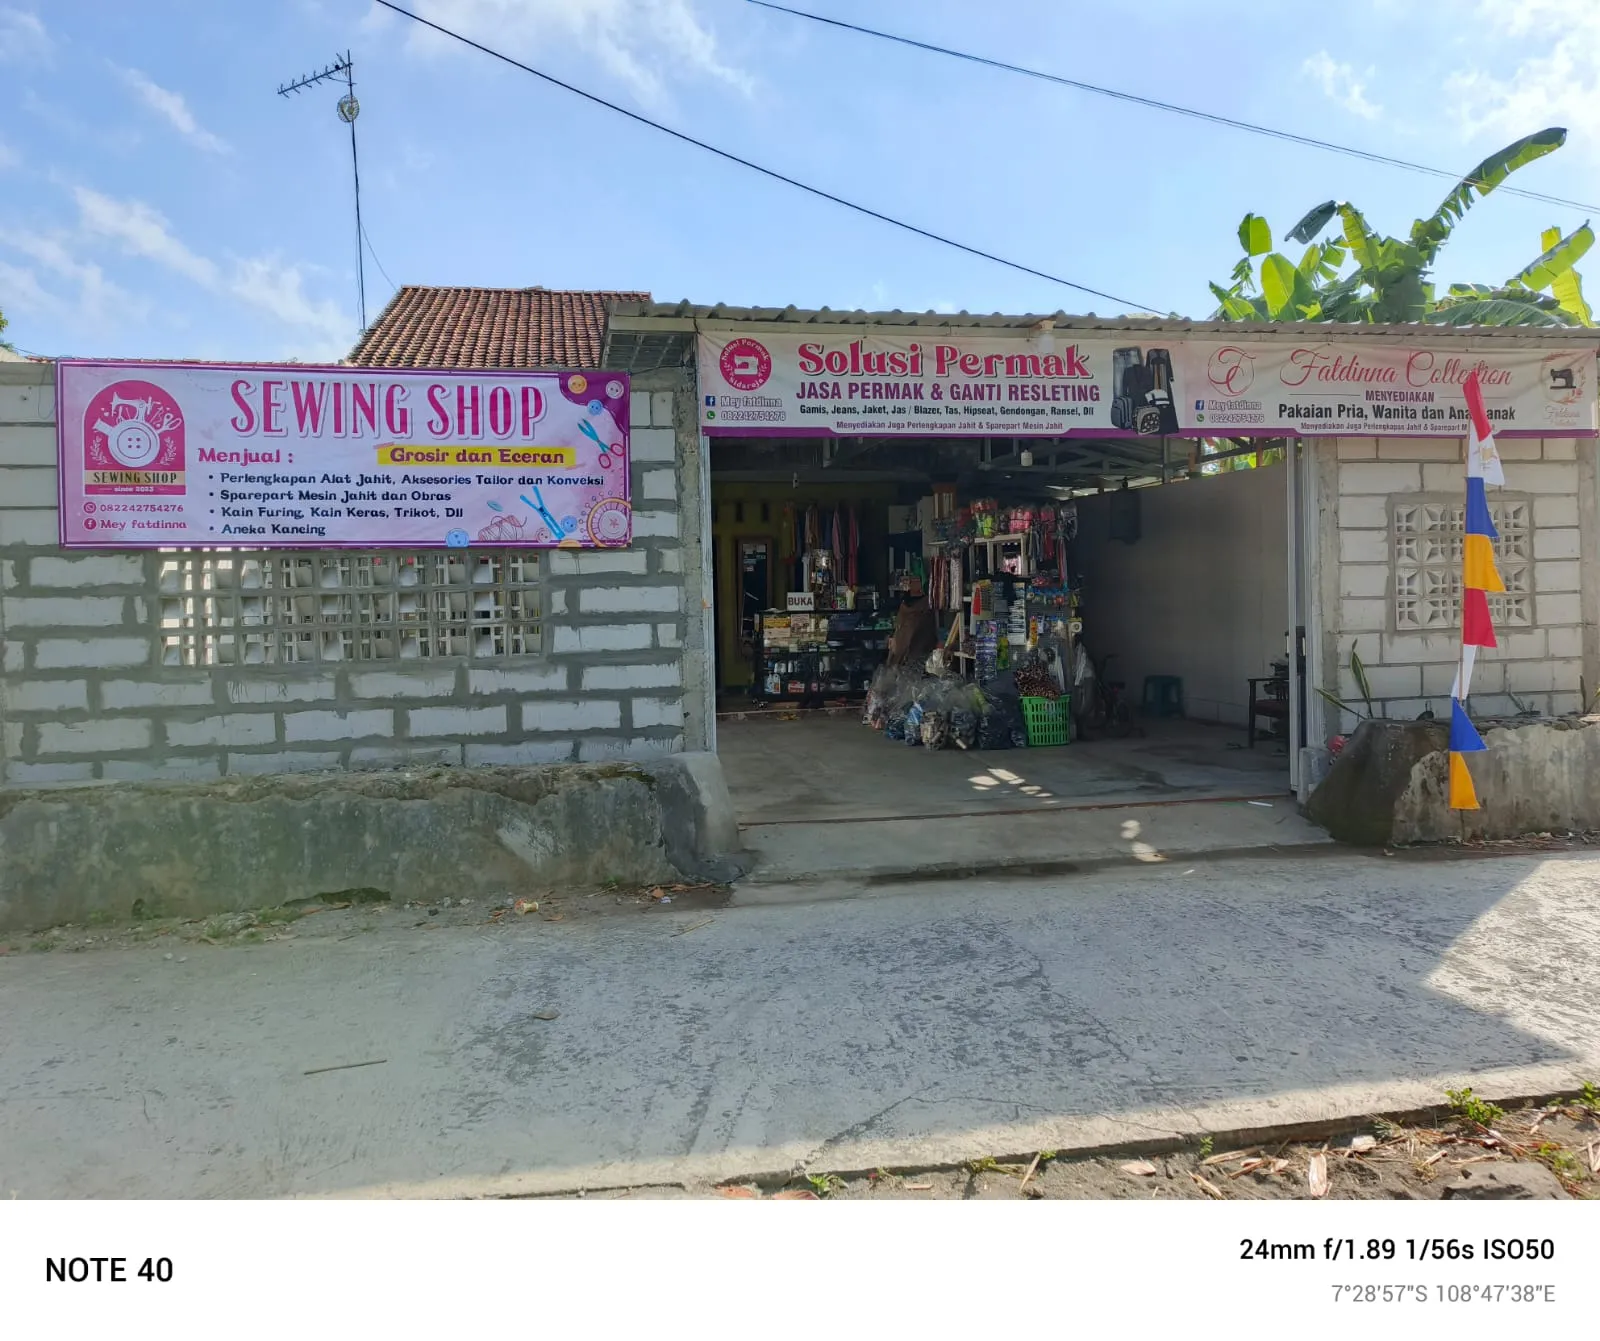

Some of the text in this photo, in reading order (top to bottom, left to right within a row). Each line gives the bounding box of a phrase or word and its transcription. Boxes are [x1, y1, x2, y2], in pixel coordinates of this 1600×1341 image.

[798, 340, 1094, 379] Solusi Permak
[1406, 351, 1512, 388] Colletion
[796, 381, 1100, 402] JASA PERMAK & GANTI RESLETING
[1365, 390, 1435, 403] MENYEDIAKAN
[720, 395, 740, 409] Mey
[230, 379, 545, 441] SEWING SHOP
[799, 404, 829, 416] Gamis,
[831, 405, 860, 416] Jeans,
[862, 405, 889, 416] Jaket,
[891, 405, 907, 415] Jas
[914, 405, 942, 416] Blazer,
[944, 405, 961, 417] Tas,
[963, 405, 998, 417] Hipseat,
[999, 406, 1049, 417] Gendongan,
[1050, 407, 1081, 417] Ransel,
[1278, 403, 1516, 421] Pakaian Pria, Wanita dan Anaanak
[836, 421, 885, 431] Menyediakan
[887, 421, 905, 431] Juga
[907, 422, 956, 432] Perlengkapan
[958, 422, 976, 430] Jahit
[978, 422, 984, 430] &
[986, 422, 1021, 431] Sparepart
[198, 448, 281, 466] Menjual
[390, 448, 565, 464] Grosir dan Eceran
[93, 472, 177, 484] SEWING SHOP
[220, 472, 604, 487] Perlengkapan Alat Jahit, Aksesories Tailor dan Konveksi
[220, 490, 451, 504] Sparepart Mesin Jahit dan Obras
[100, 504, 184, 512] 082242754276
[221, 507, 254, 517] Kain
[257, 507, 305, 520] Furing,
[310, 507, 342, 518] Kain
[346, 507, 389, 519] Keras,
[394, 507, 440, 519] Trikot,
[100, 520, 187, 530] Mey fatdinna
[221, 524, 326, 536] Aneka Kancing
[788, 597, 812, 606] BUKA
